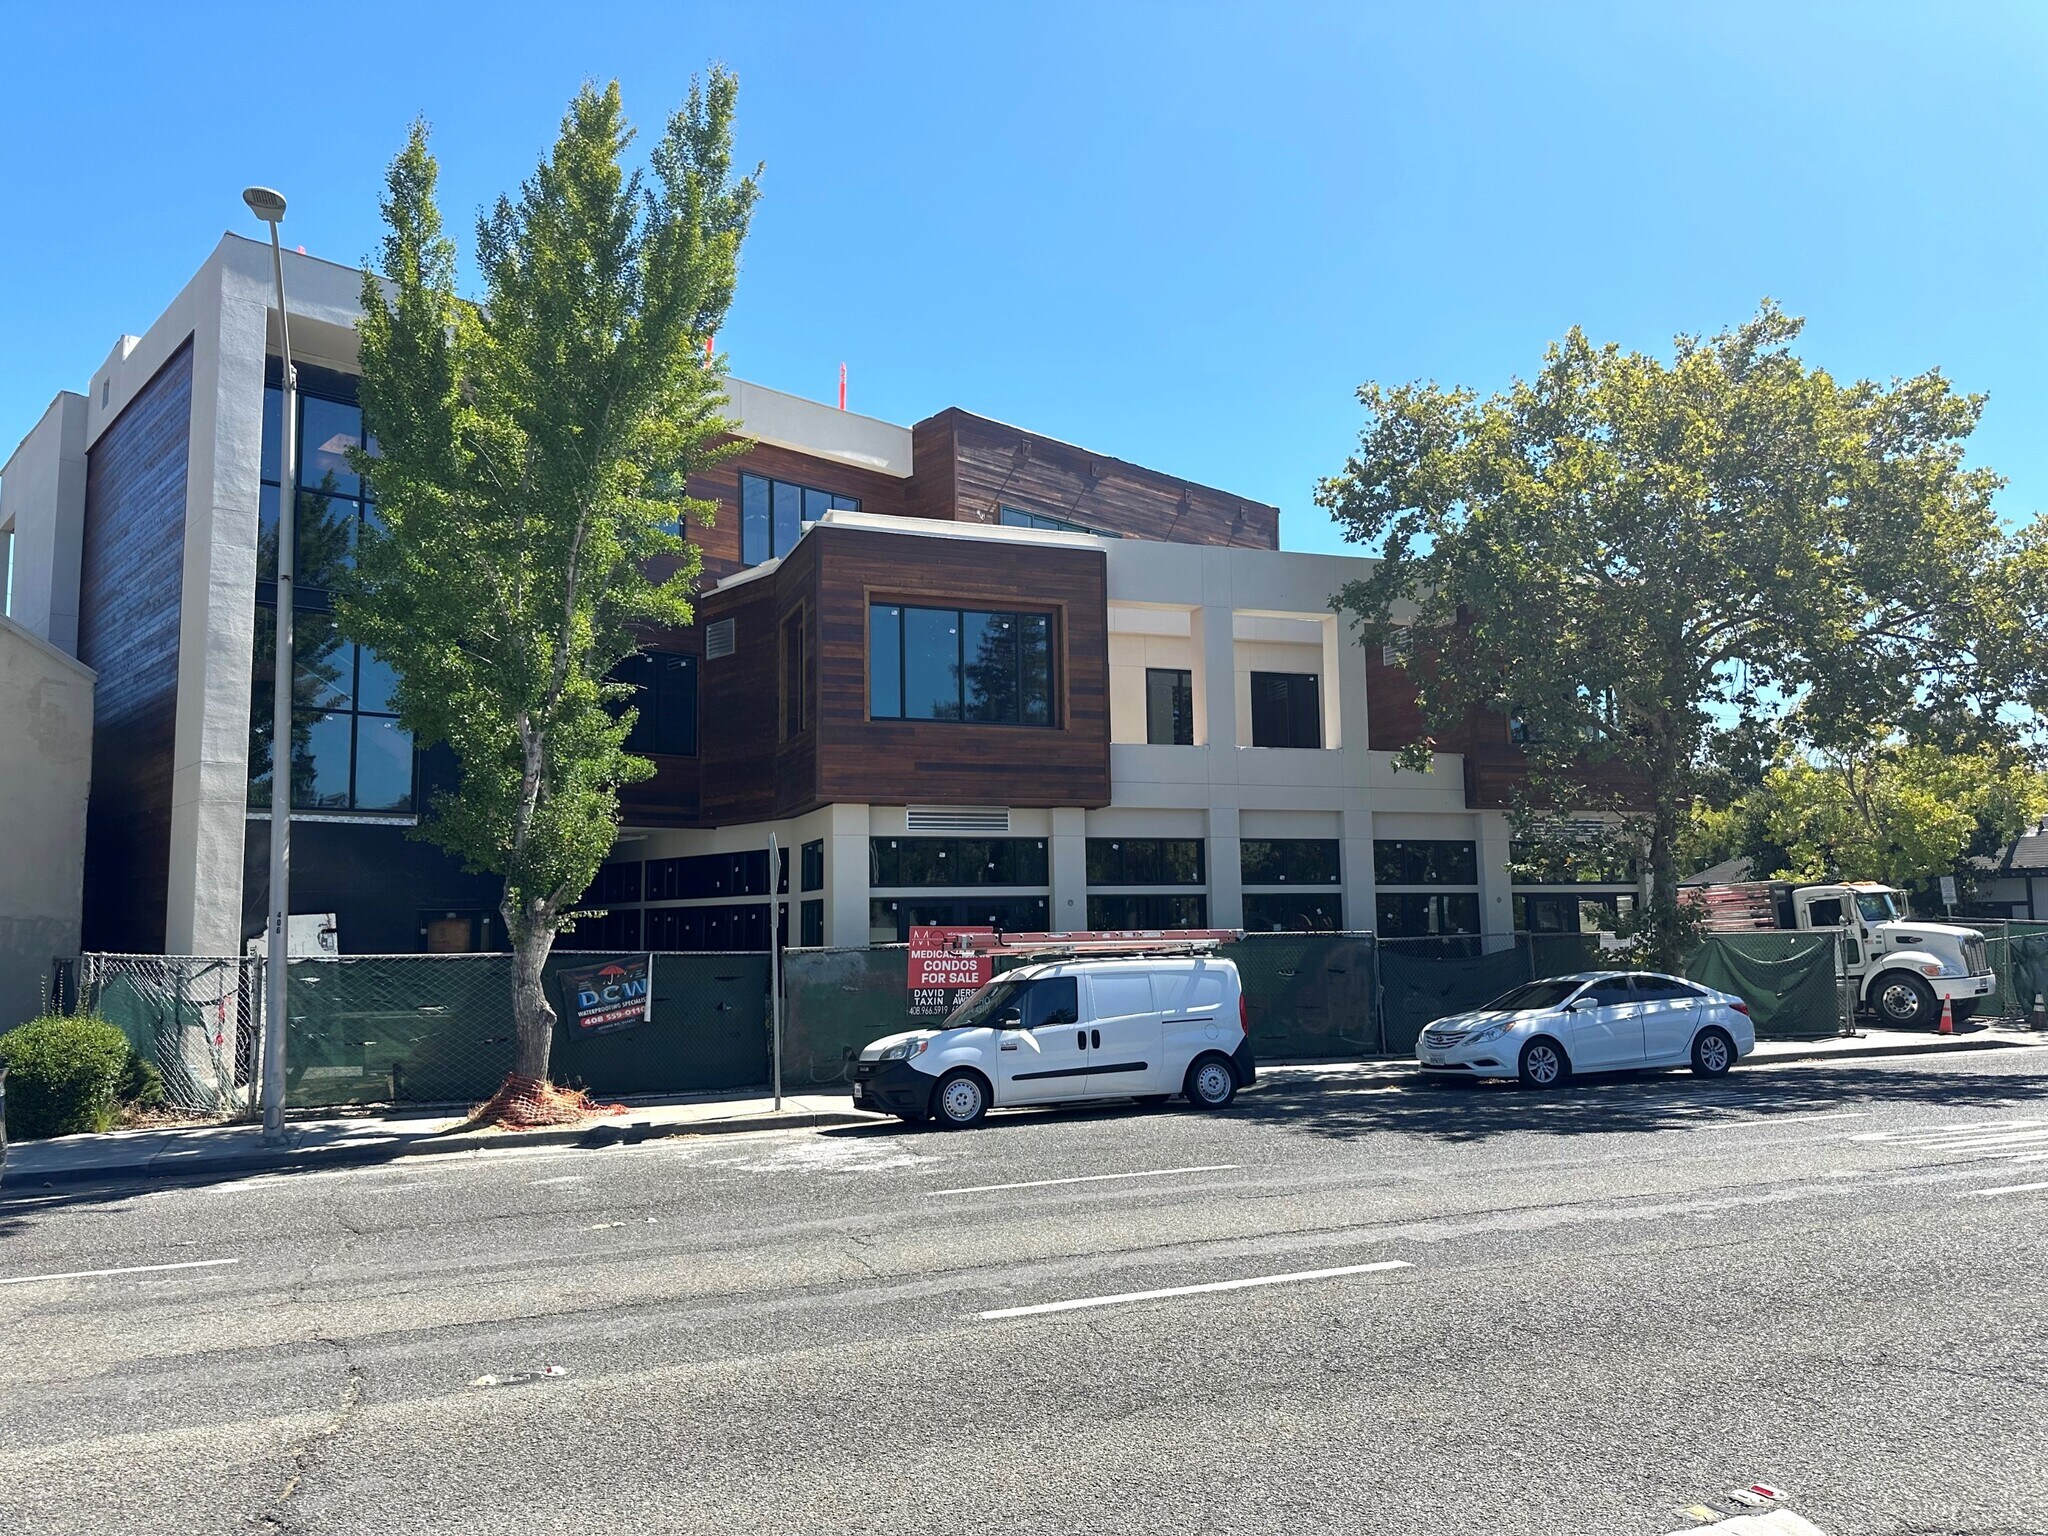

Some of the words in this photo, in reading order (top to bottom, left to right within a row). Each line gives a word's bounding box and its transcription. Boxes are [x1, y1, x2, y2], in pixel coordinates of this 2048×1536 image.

[923, 960, 978, 971] CONDOS
[921, 973, 946, 984] FOR
[949, 972, 979, 983] SALE
[577, 978, 647, 1007] DCW
[914, 989, 945, 997] DAVID
[914, 997, 944, 1006] TAXIN
[578, 1002, 622, 1017] WATERPROOFING
[909, 1005, 948, 1015] 408.966.5919
[584, 1015, 604, 1025] 408
[606, 1006, 646, 1021] 559-0110
